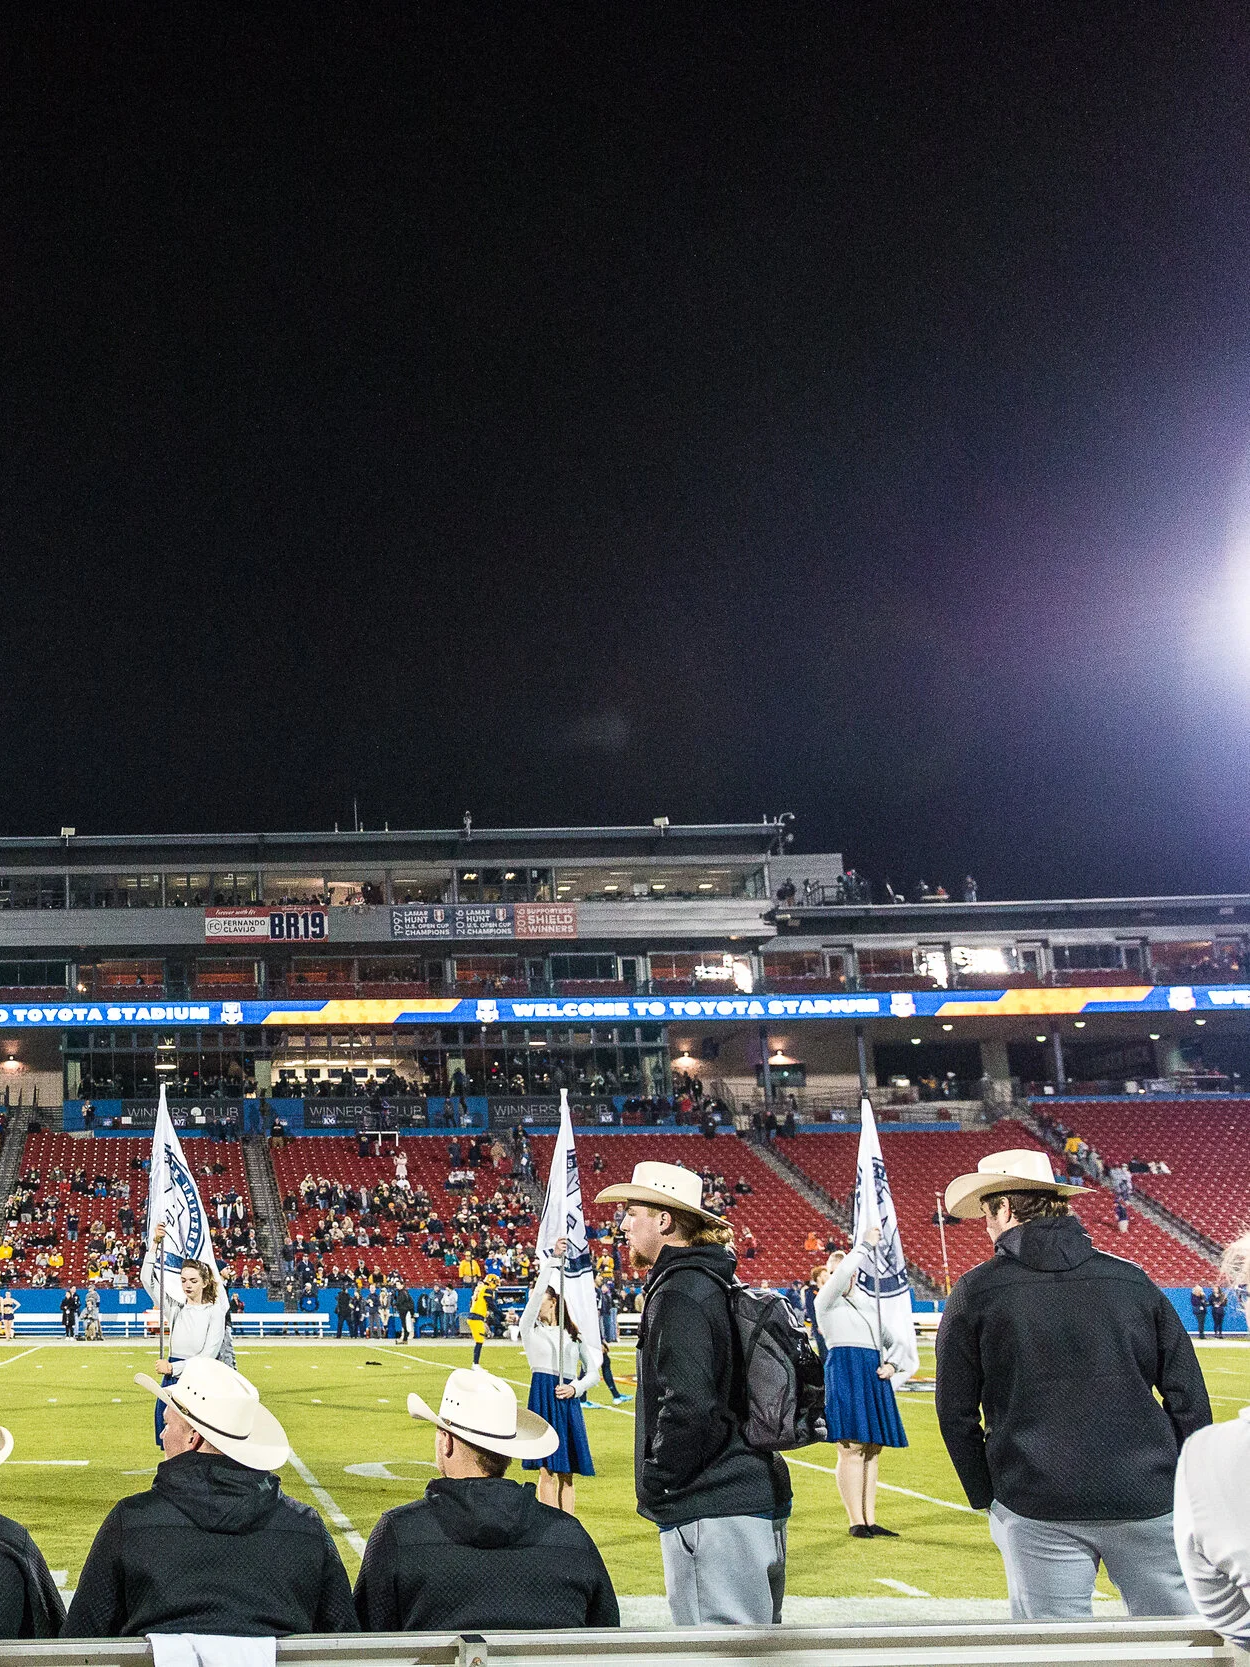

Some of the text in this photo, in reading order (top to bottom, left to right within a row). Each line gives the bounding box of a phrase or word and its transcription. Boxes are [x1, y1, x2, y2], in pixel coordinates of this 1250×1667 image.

[270, 911, 325, 940] BR19
[393, 911, 403, 935] 1997
[456, 910, 465, 934] 2016
[517, 909, 526, 932] 2016
[528, 914, 573, 924] SHIELD
[13, 1008, 102, 1022] TOYOTA
[107, 1007, 209, 1020] STADIUM
[512, 999, 879, 1017] WELCOME TO TOYOTA STADIUM
[127, 1106, 238, 1117] WINNRS CLUB
[310, 1106, 372, 1117] WINNERS
[494, 1105, 557, 1116] WINNERS
